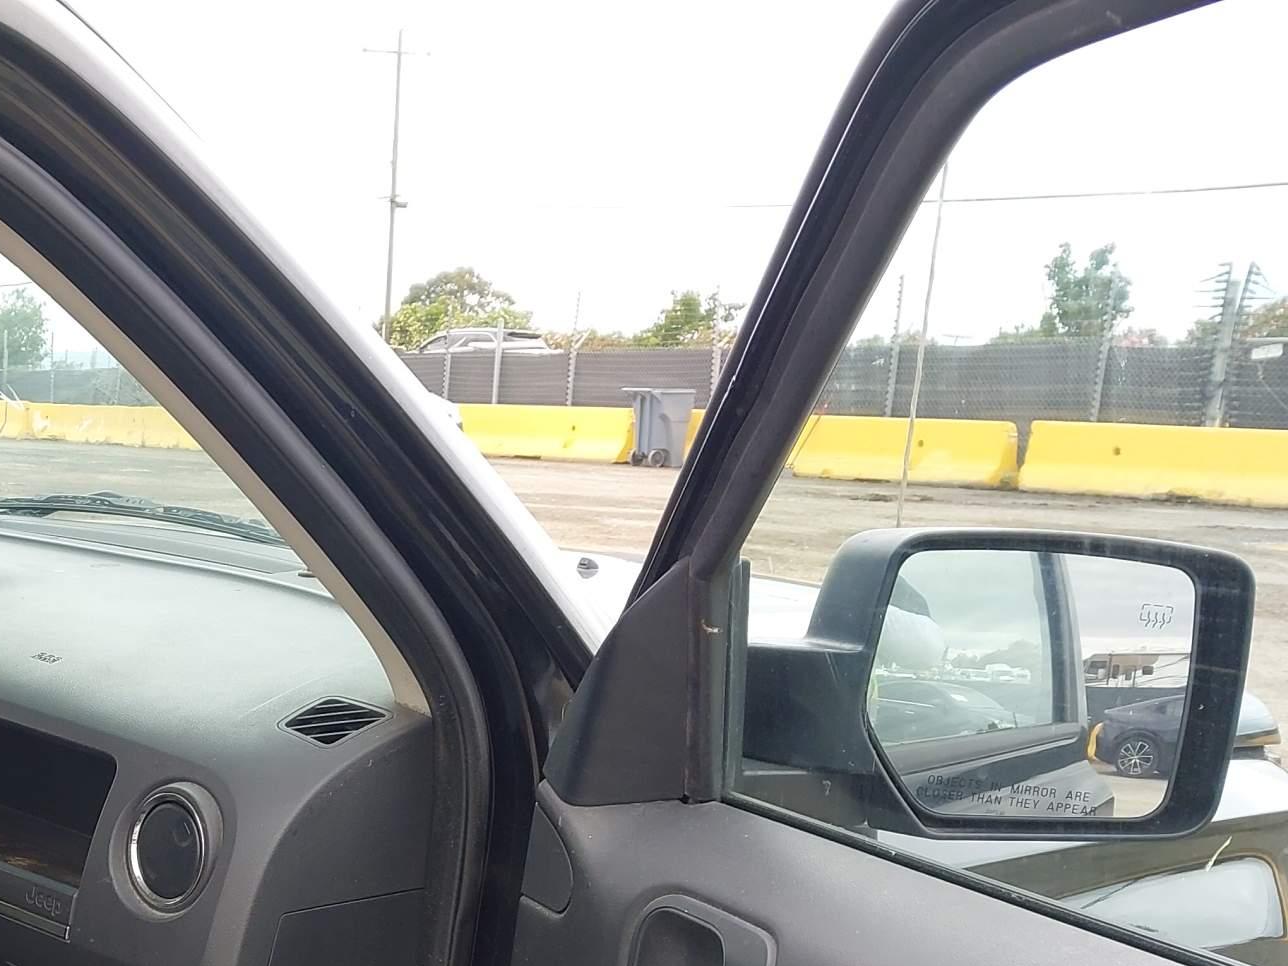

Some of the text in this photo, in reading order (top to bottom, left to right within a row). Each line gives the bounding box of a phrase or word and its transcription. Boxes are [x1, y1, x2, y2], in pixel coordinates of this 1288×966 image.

[916, 786, 1097, 817] CLOSER THAN THEY APPEAR
[927, 774, 1091, 803] OBJECTS IN MIRROR ARE
[25, 886, 61, 916] Jeep
